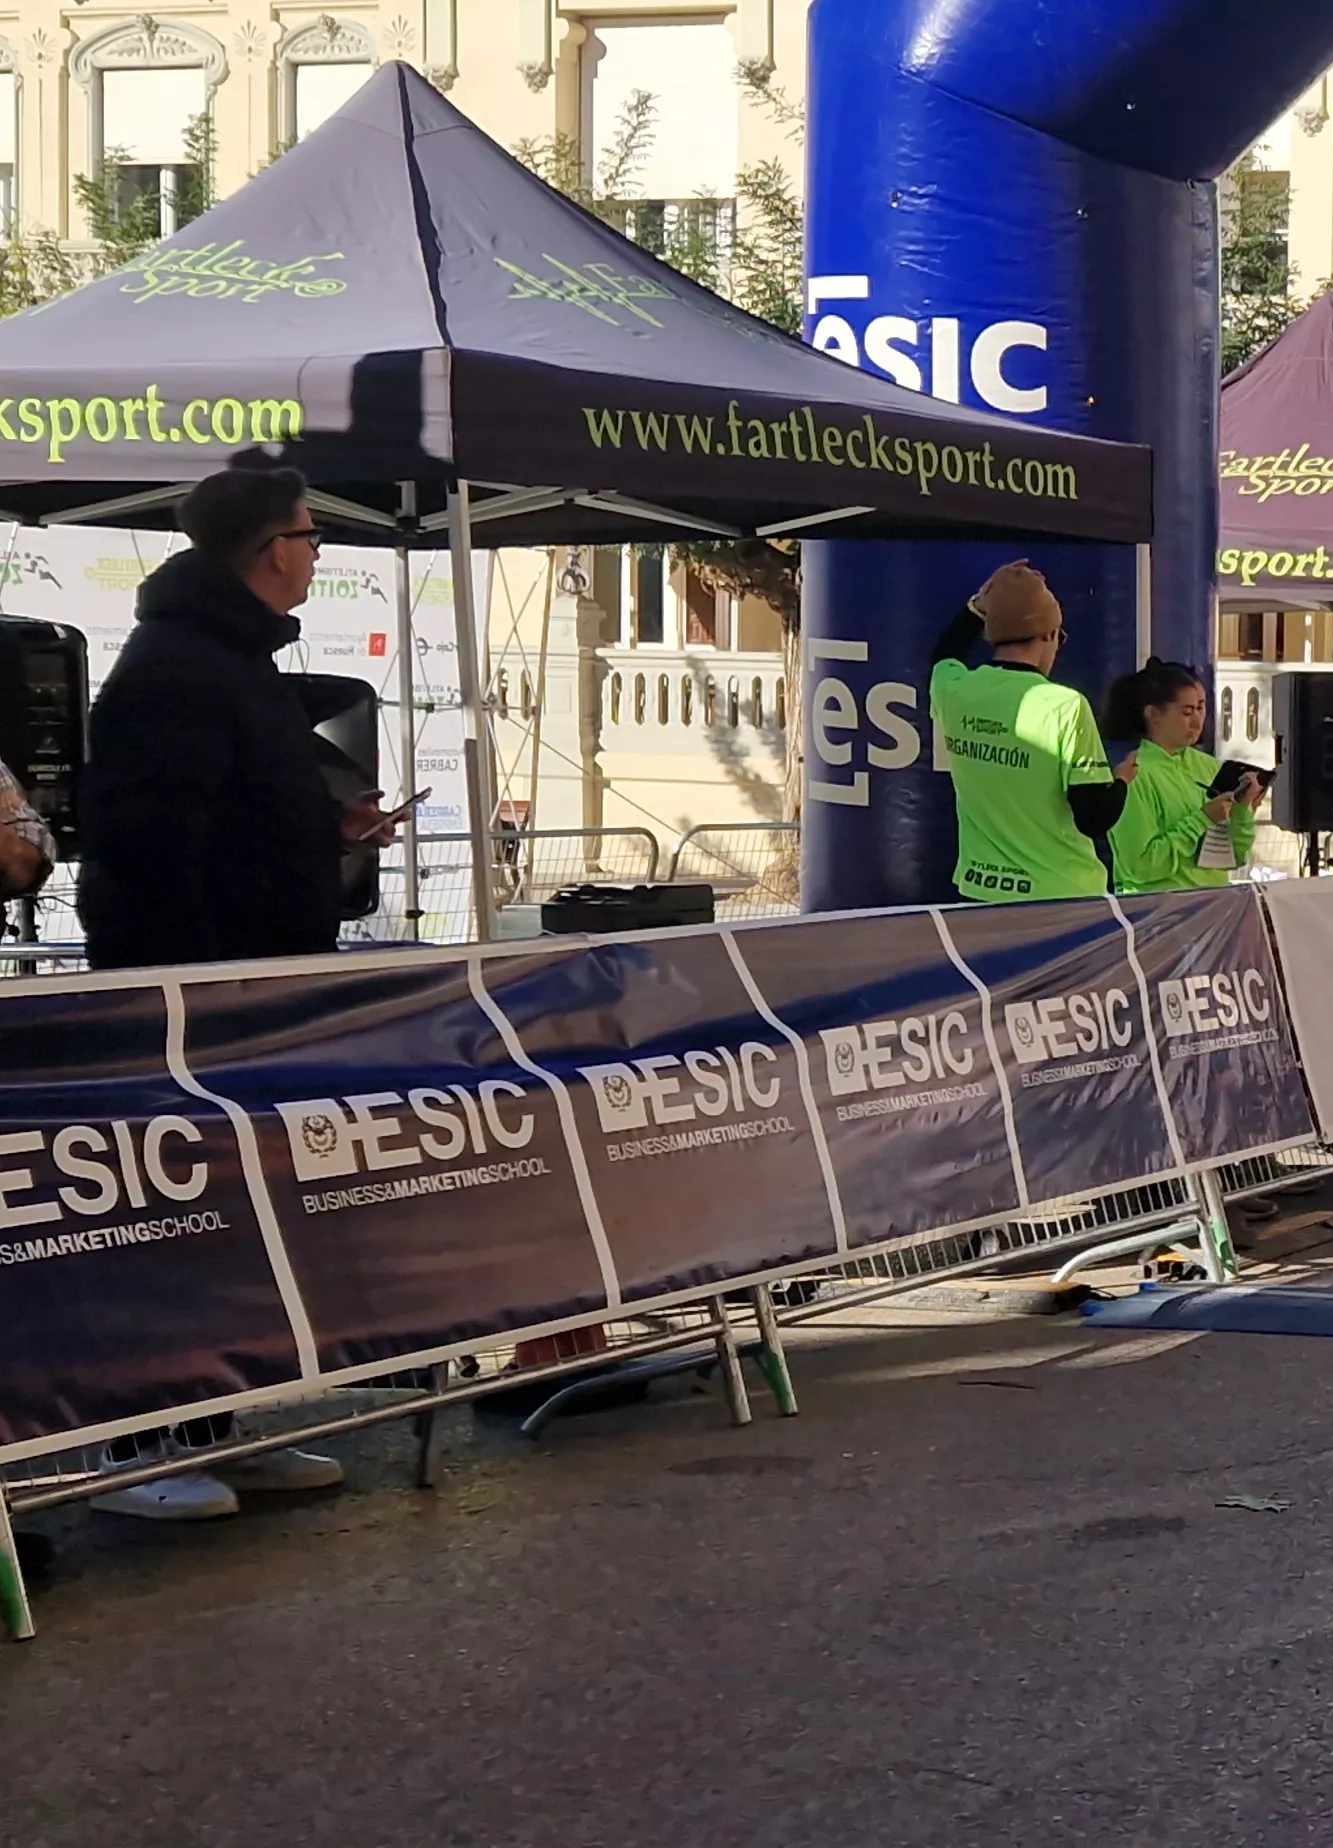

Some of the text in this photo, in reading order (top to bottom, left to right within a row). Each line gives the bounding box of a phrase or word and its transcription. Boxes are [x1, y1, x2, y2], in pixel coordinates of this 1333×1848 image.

[120, 266, 280, 304] Sport
[582, 400, 1079, 501] www.fartlecksport.com
[944, 735, 1030, 769] RGANIZACIÓN
[1036, 988, 1132, 1059] ESIC
[1184, 968, 1270, 1033] ESIC
[630, 1041, 780, 1126] ESIC
[862, 1011, 973, 1090] ESIC
[342, 1079, 535, 1171] ESIC
[606, 1115, 795, 1162] BUSINESS&MARKETINGSCHOOL
[0, 1114, 208, 1229] ESIC
[302, 1157, 552, 1214] BUSINESS&MARKETINGSCHOOL
